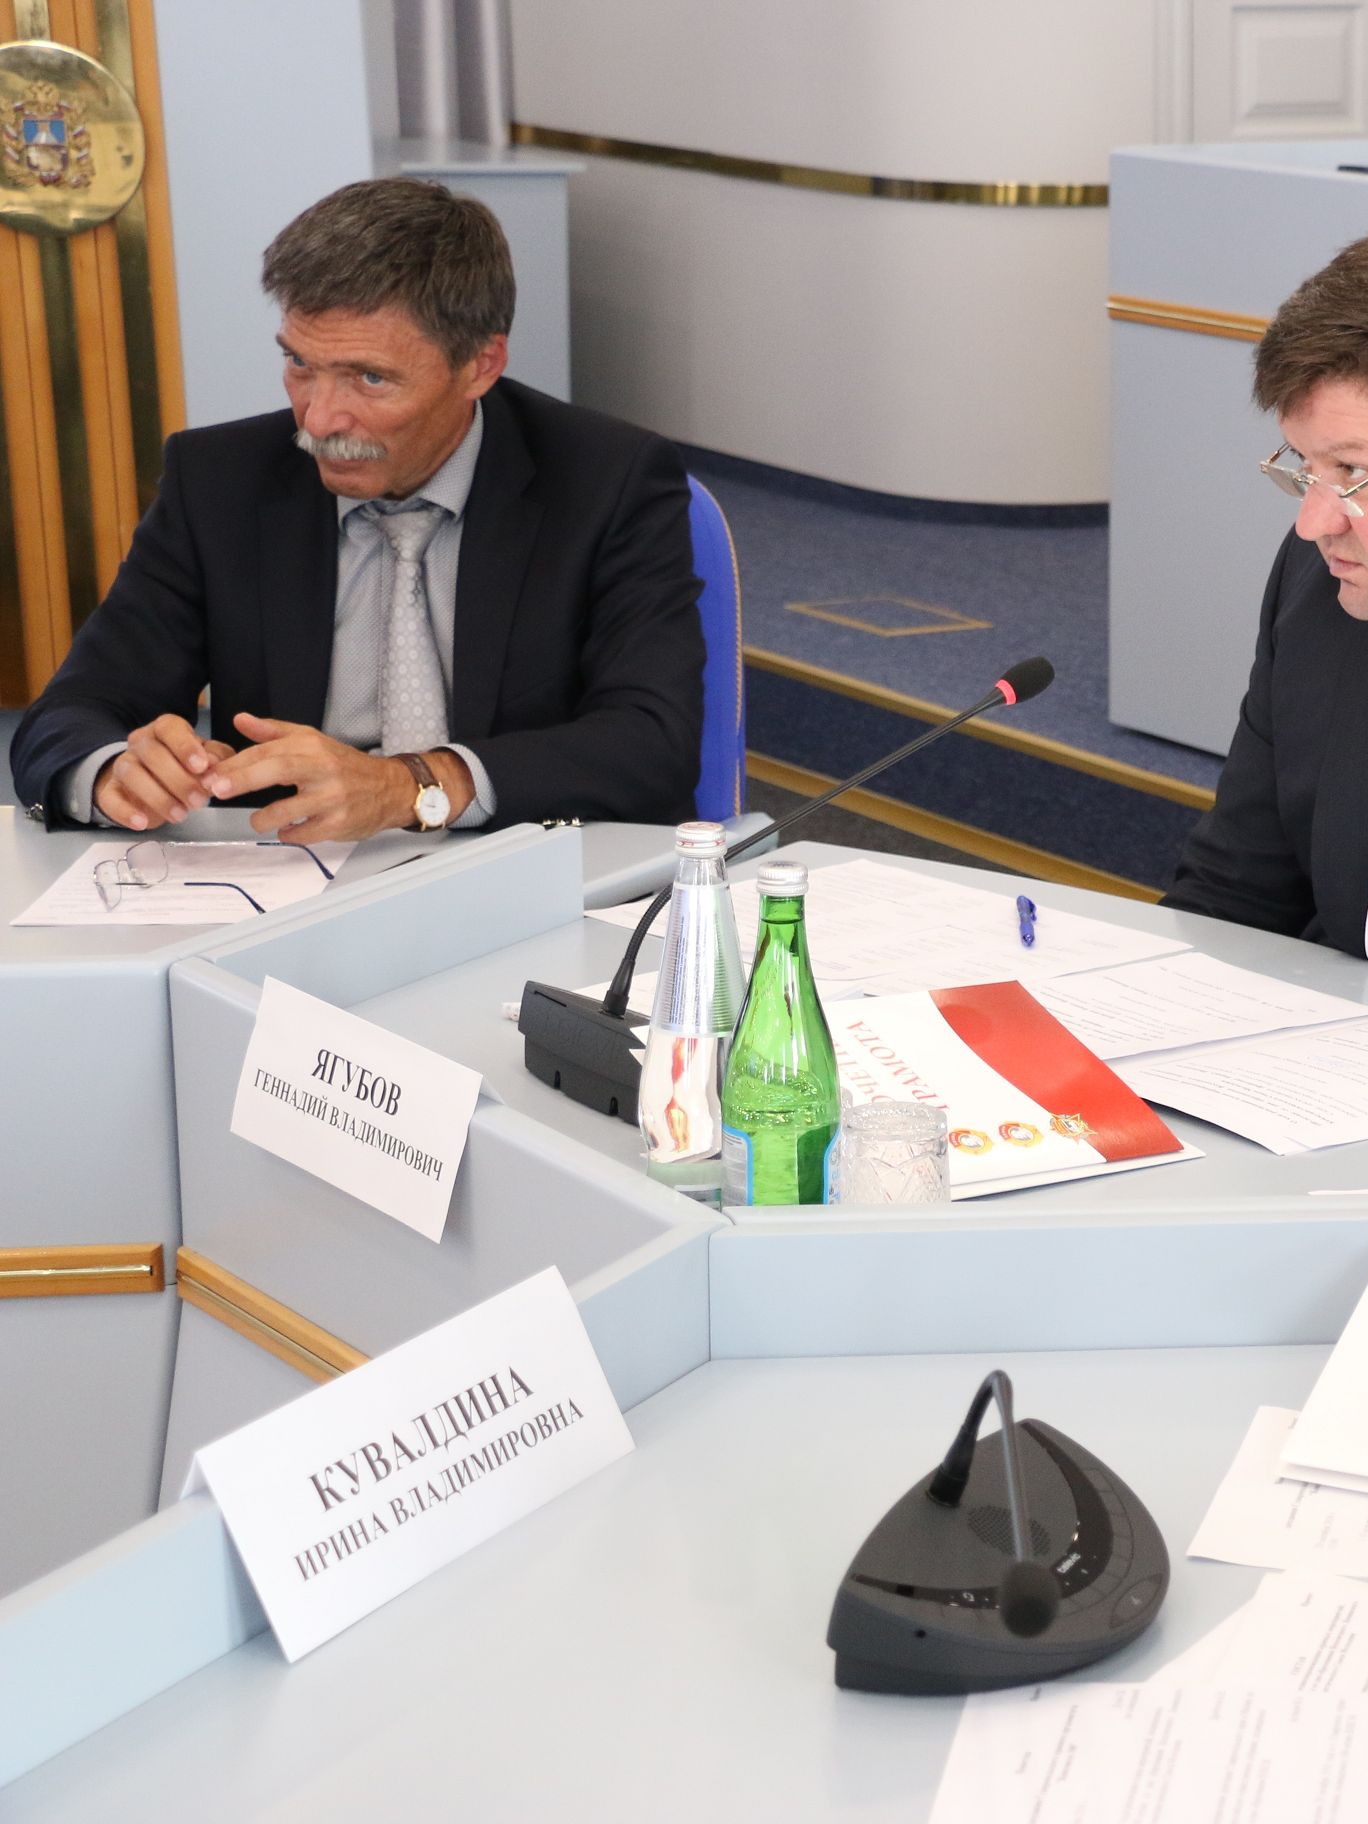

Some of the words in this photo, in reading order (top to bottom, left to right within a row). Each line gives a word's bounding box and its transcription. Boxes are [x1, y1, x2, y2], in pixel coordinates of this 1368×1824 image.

[255, 1069, 329, 1121] ГЕННАДИЙ
[329, 1108, 443, 1181] ВЛАДИМИРОВИЧ
[312, 1048, 402, 1116] ЯГУБОВ
[294, 1511, 390, 1581] ИРИНА
[389, 1397, 584, 1527] ВЛАДИМИРОВНА
[308, 1366, 534, 1511] КУВАЛДИНА
